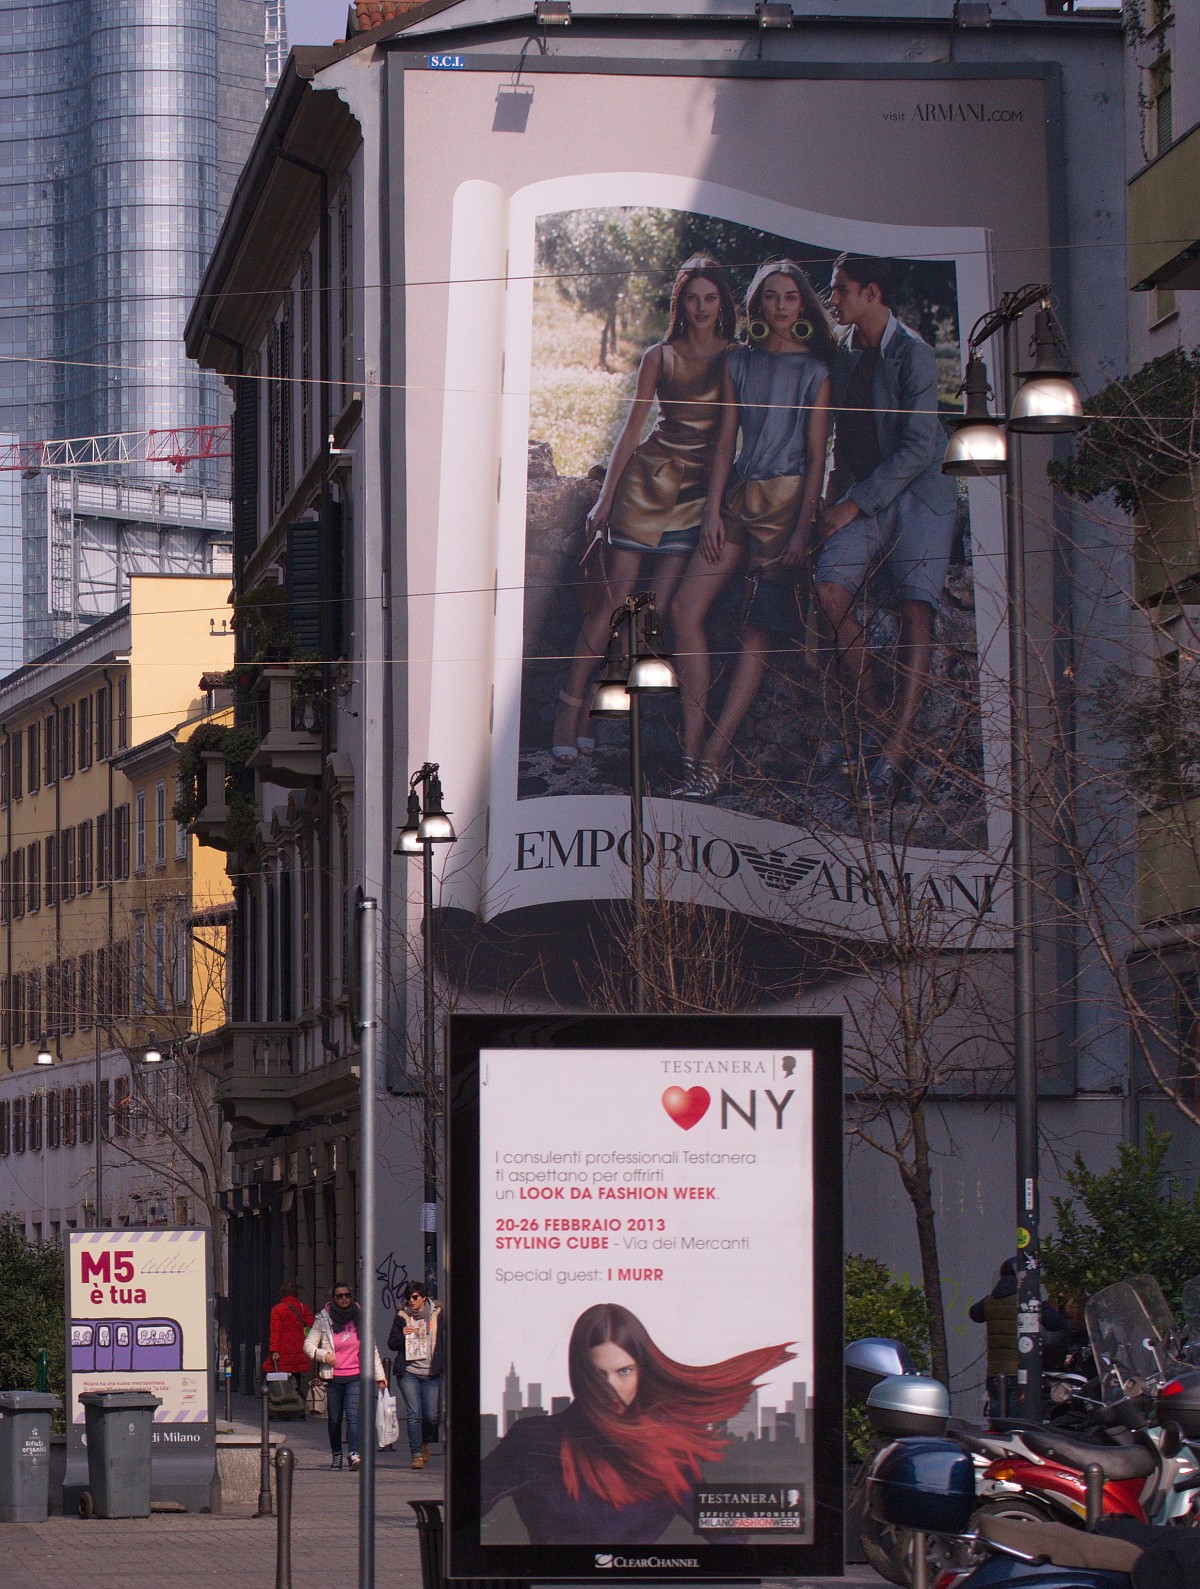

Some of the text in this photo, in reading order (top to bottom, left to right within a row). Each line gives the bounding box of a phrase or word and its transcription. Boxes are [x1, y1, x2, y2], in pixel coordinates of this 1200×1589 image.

[431, 55, 464, 67] S.C.I.
[883, 103, 1023, 122] visit ARMANI.COM
[514, 828, 741, 880] EMPORIO
[809, 859, 996, 914] ARMANI
[661, 1060, 766, 1073] TESTANERA
[720, 1088, 796, 1131] NY
[495, 1151, 756, 1167] I consulenti professionali Testanera
[496, 1169, 664, 1186] ti aspettano per offrirti
[496, 1187, 720, 1200] un LOOK DA FASHION WEEK.
[496, 1218, 665, 1232] 20-26 FEBBRAIO 2013
[496, 1237, 561, 1250] STYLING
[567, 1237, 608, 1250] CUBE
[623, 1237, 647, 1250] Via
[652, 1237, 676, 1250] dei
[681, 1237, 749, 1250] Mercanti
[81, 1251, 135, 1283] M5
[496, 1268, 663, 1284] Special guest: I MURR
[90, 1283, 147, 1304] è tua
[151, 1432, 201, 1443] di Milano
[22, 1446, 47, 1454] organici
[699, 1493, 777, 1504] TESTANERA
